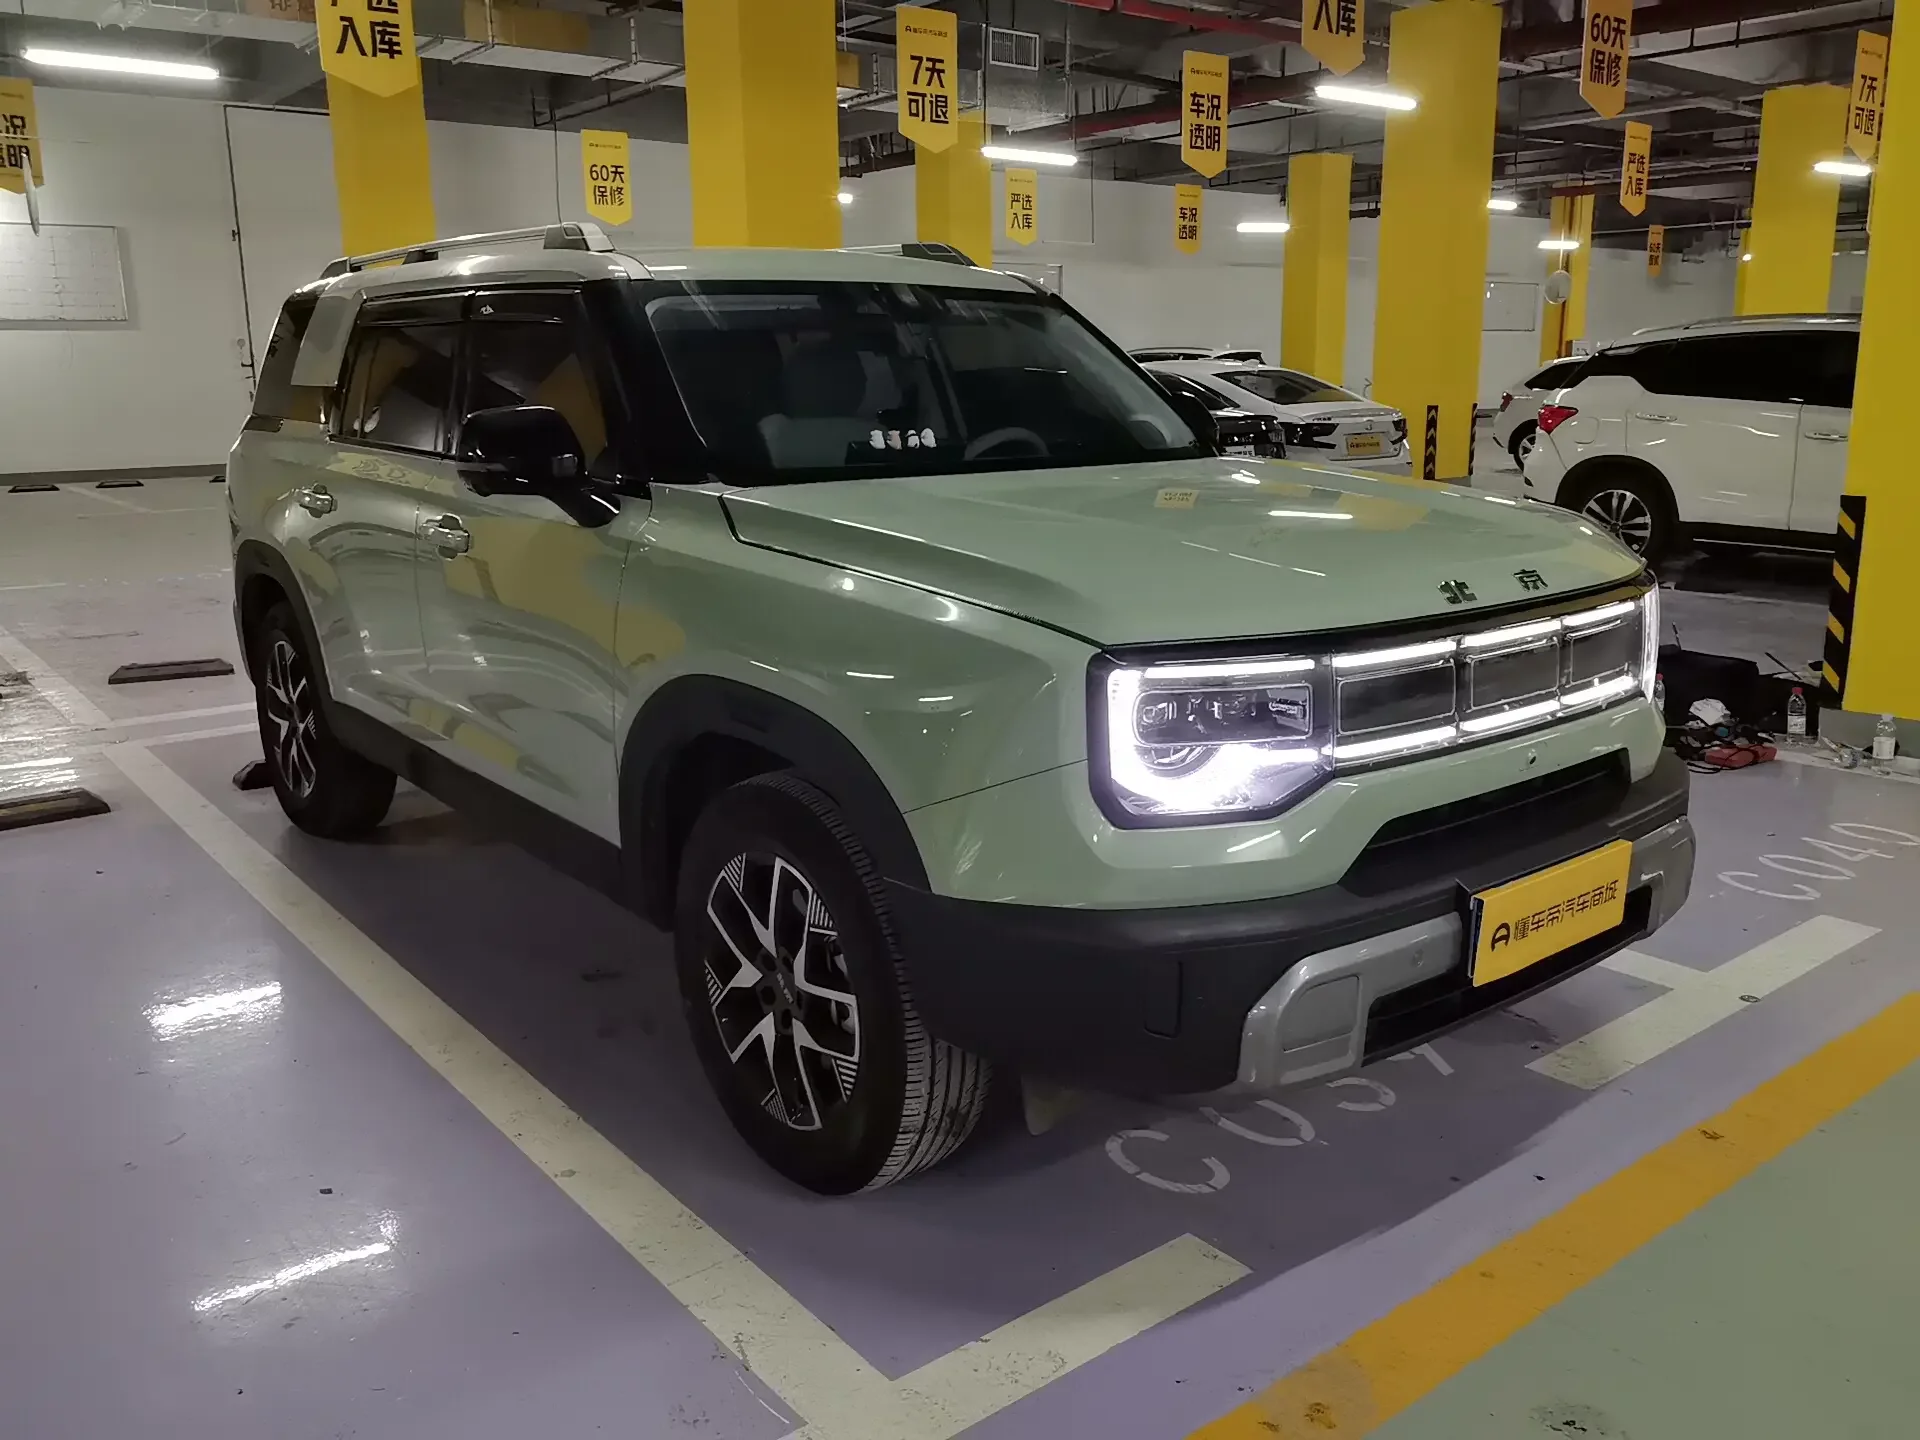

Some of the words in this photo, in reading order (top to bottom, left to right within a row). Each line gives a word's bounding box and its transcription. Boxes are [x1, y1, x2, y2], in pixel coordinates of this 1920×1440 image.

[336, 16, 403, 59] 入库
[1591, 13, 1627, 50] 60天
[909, 54, 946, 88] 7天
[1590, 48, 1622, 87] 保修
[1859, 74, 1878, 104] 7天
[907, 91, 949, 124] 可退
[1190, 91, 1222, 121] 车况
[1854, 106, 1876, 136] 可退
[0, 114, 30, 140] 况
[1190, 123, 1221, 152] 透明
[589, 164, 625, 183] 60天
[1626, 152, 1646, 174] 严选
[593, 185, 625, 206] 保修
[1010, 193, 1033, 210] 严选
[1625, 176, 1644, 197] 入库
[1010, 212, 1033, 230] 入库
[1178, 206, 1198, 223] 车况
[1178, 224, 1198, 241] 透明
[1437, 568, 1549, 606] 北京
[1717, 822, 1920, 900] C040
[1513, 879, 1619, 942] 懂车帝汽车商城
